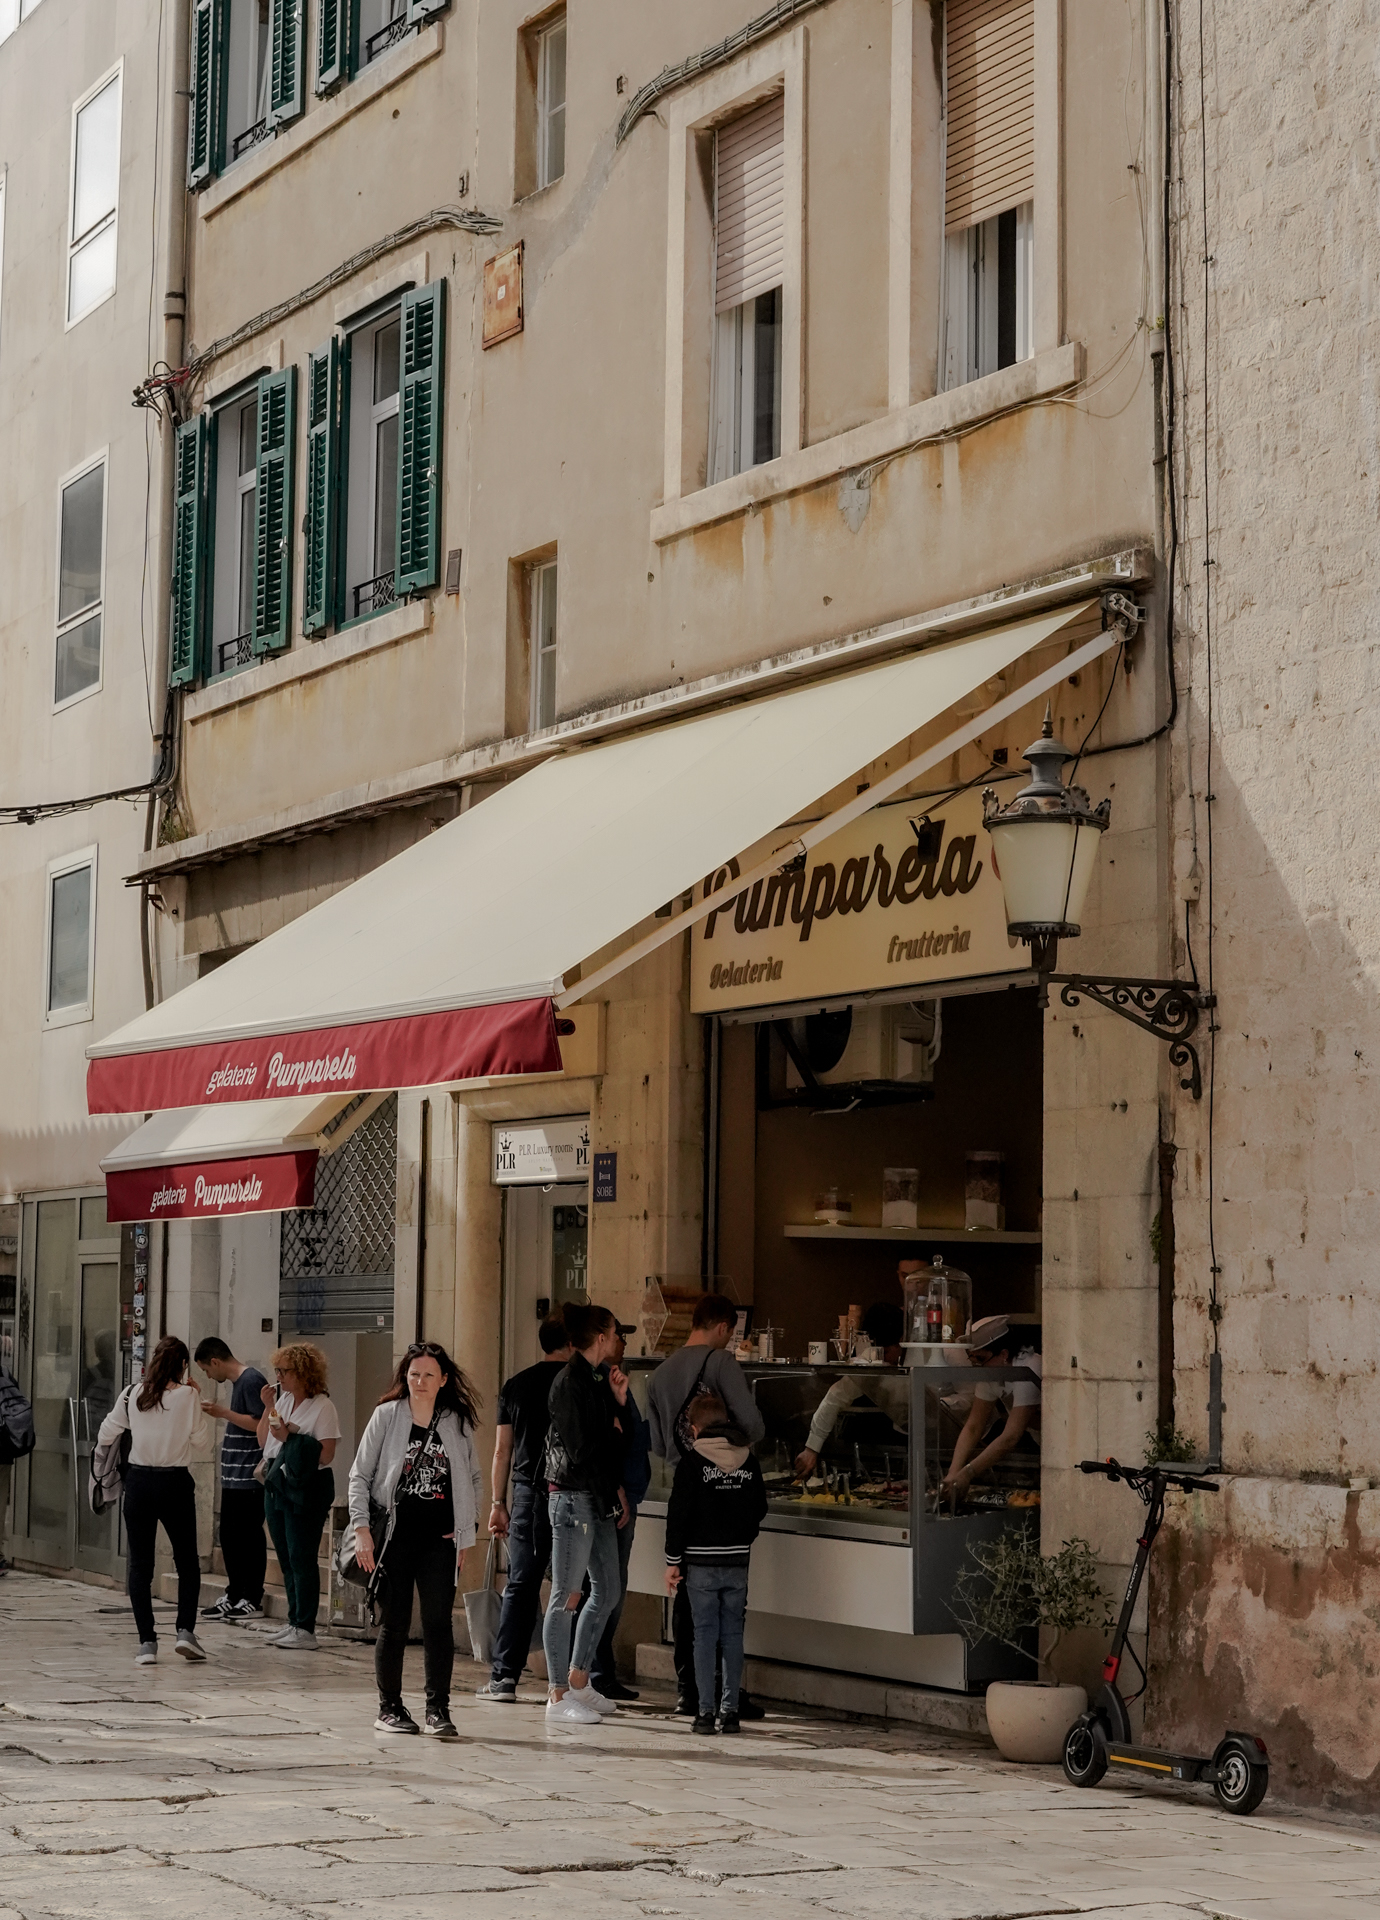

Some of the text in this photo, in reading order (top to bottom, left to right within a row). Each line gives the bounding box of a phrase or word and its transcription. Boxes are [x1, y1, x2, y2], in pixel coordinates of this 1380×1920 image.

[887, 925, 970, 964] frutteria
[206, 1047, 357, 1095] gelateria Pumparela
[496, 1153, 516, 1170] PLR
[519, 1143, 574, 1156] PLR Luxury rooms
[150, 1173, 262, 1213] gelateria Pumparela
[596, 1186, 613, 1197] SOBE
